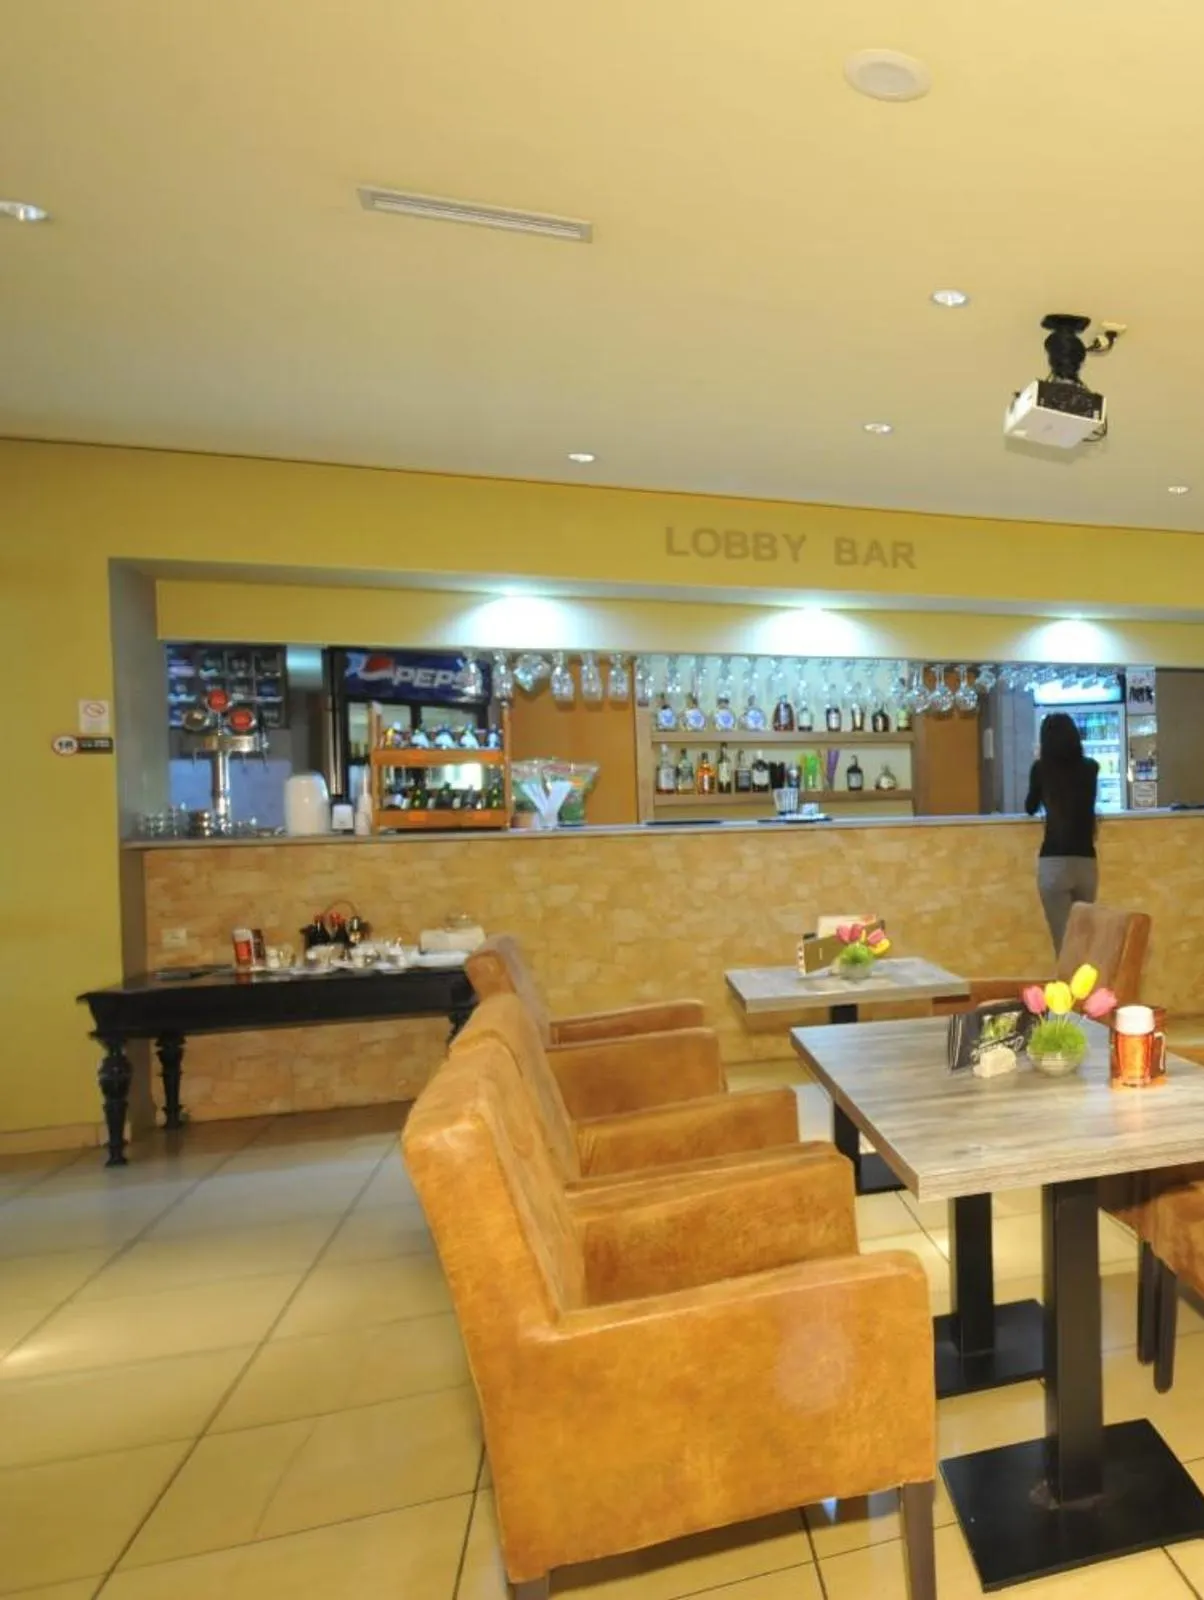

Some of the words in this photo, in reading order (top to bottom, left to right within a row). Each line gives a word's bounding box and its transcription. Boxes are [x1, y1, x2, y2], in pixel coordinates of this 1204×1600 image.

[664, 526, 807, 564] LOBBY
[833, 536, 918, 570] BAR
[391, 665, 476, 692] PEPS
